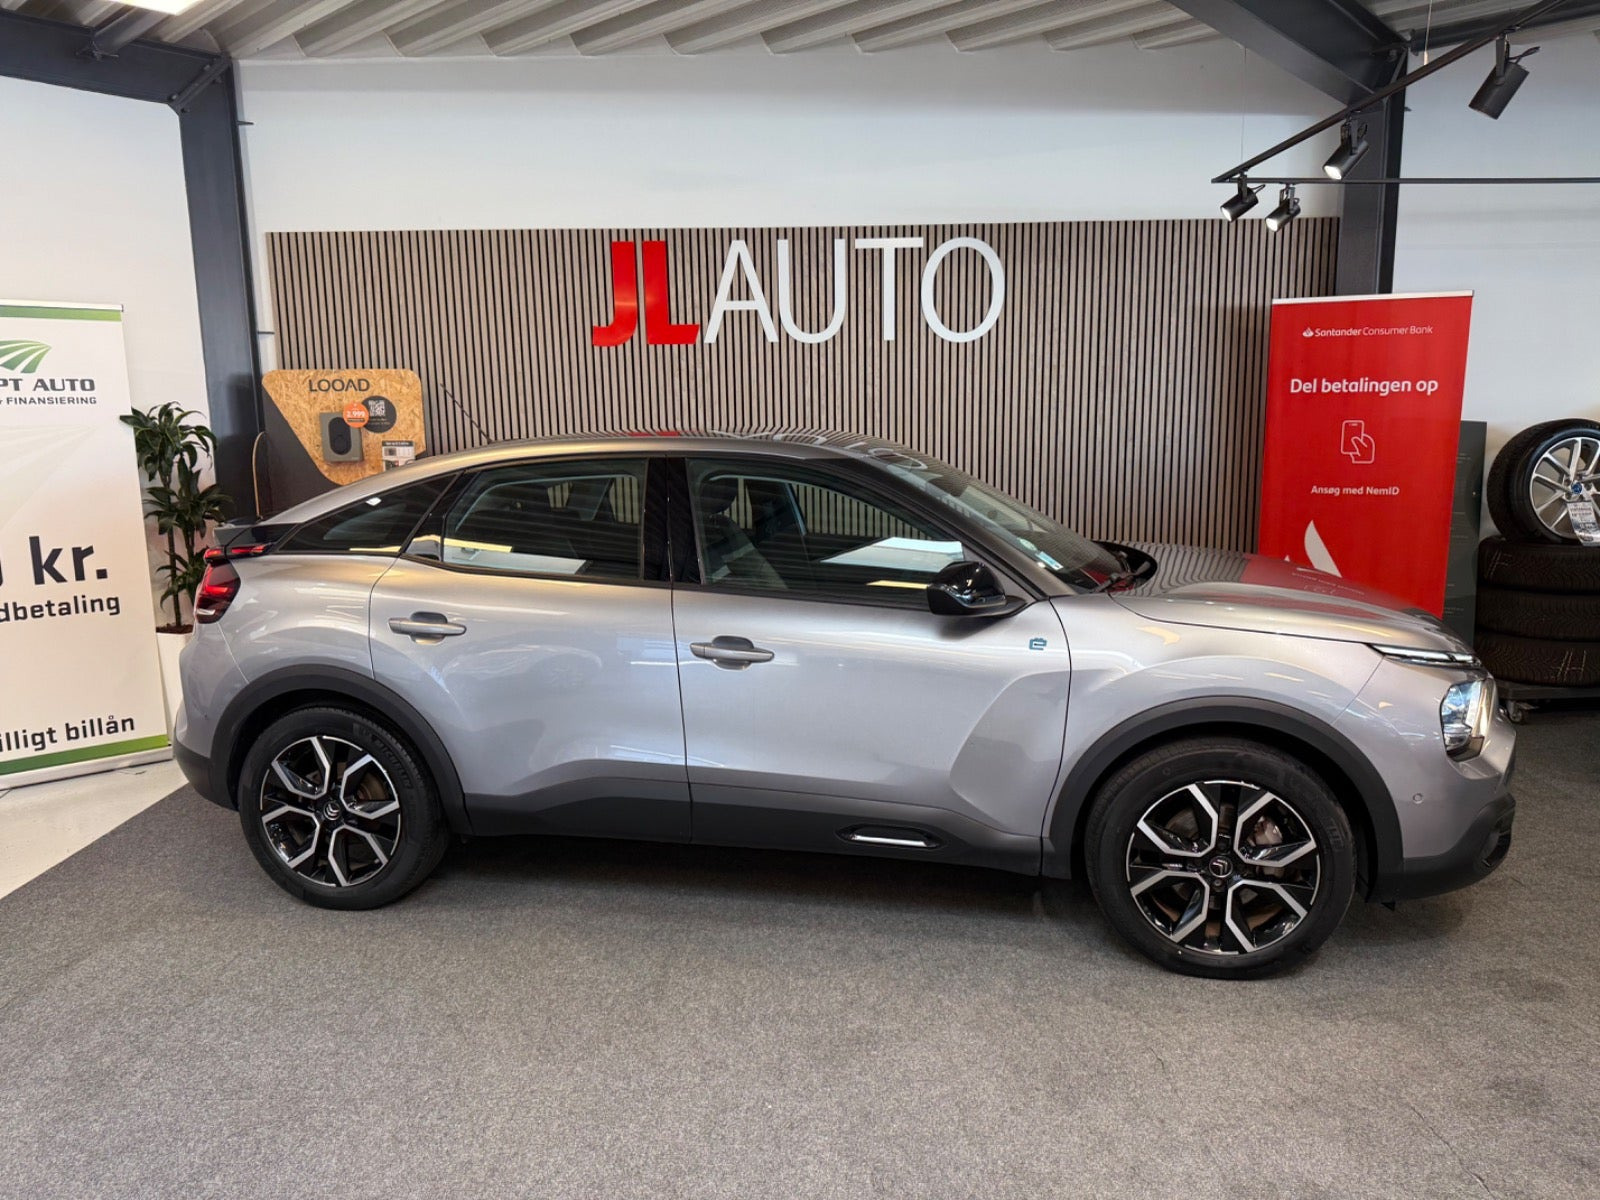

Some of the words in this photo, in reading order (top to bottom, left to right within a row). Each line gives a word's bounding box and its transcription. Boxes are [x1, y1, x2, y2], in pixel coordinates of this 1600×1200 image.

[703, 236, 1006, 344] AUTO
[1314, 327, 1362, 337] Santander
[1362, 326, 1409, 336] Consumer
[1409, 325, 1433, 335] Bank
[33, 378, 96, 391] AUTO
[1290, 378, 1317, 394] Del
[1321, 377, 1411, 396] betalingen
[1416, 379, 1439, 396] op
[6, 396, 97, 405] FINANSIERING
[1311, 485, 1340, 496] Ansøg
[1342, 485, 1364, 495] med
[1366, 485, 1400, 495] NemID
[29, 535, 108, 585] kr.
[65, 715, 135, 741] billån
